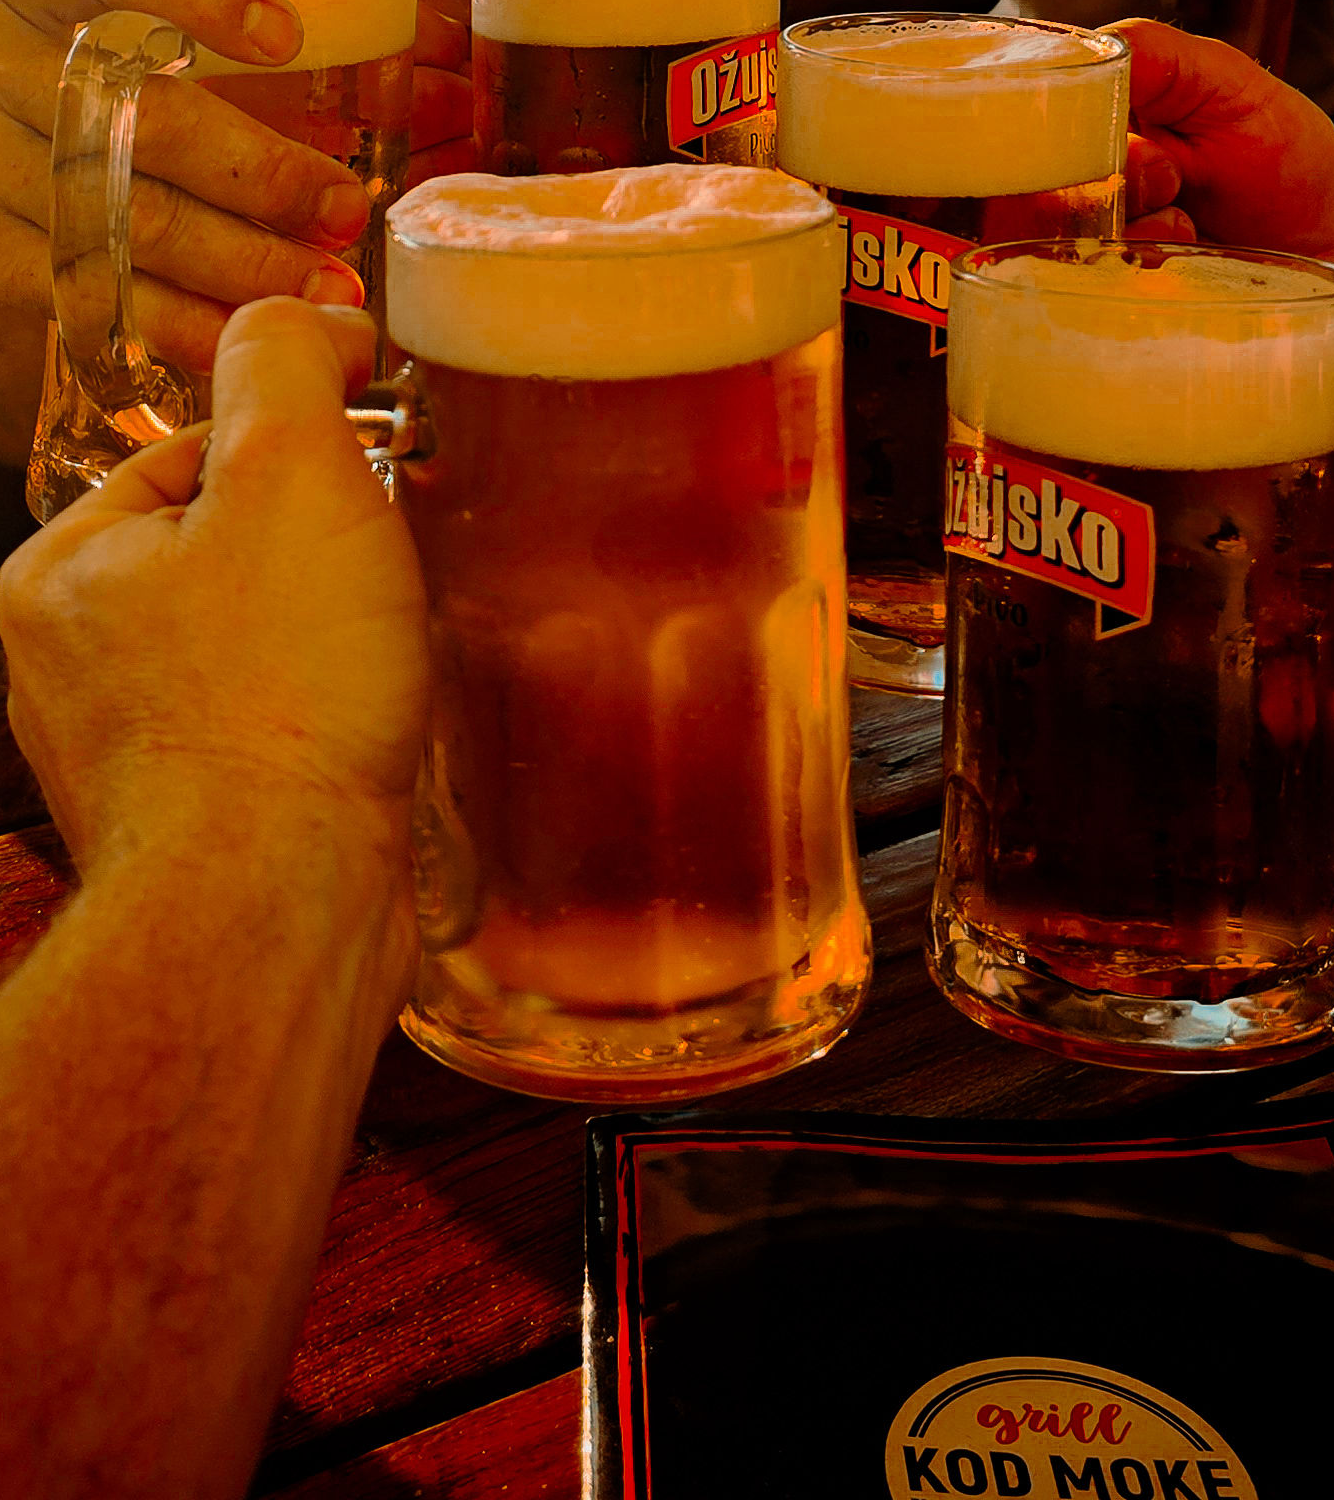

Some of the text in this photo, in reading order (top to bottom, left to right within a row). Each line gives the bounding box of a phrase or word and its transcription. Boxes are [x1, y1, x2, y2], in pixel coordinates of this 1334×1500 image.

[945, 456, 1120, 584] Ožujsko
[976, 1402, 1132, 1445] grill
[903, 1445, 1238, 1500] KOD MOKE
